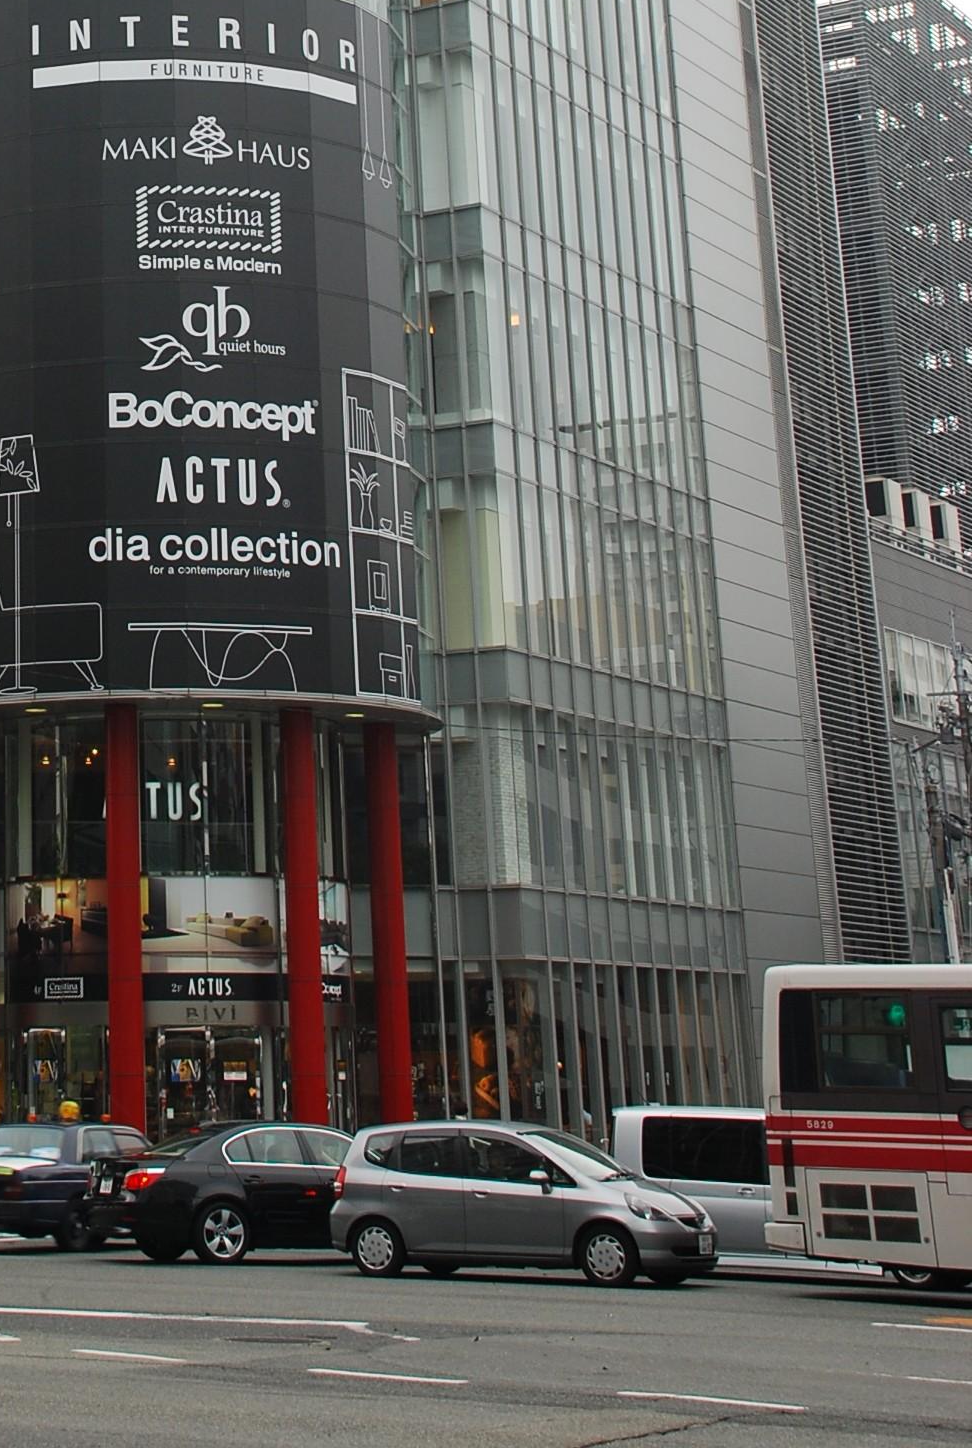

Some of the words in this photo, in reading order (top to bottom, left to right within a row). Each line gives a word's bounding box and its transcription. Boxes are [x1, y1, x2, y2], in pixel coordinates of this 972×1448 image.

[31, 15, 357, 72] INTERIOR
[150, 63, 265, 82] FURNITURE
[102, 137, 177, 161] MAKI
[237, 140, 311, 170] HAUS
[156, 200, 264, 227] Crastina
[158, 225, 195, 236] INTER
[198, 226, 265, 238] FURNITURE
[138, 254, 201, 271] Simple
[203, 259, 215, 270] &
[216, 256, 282, 274] Modern
[218, 340, 251, 354] quiet
[254, 340, 286, 356] hours
[88, 528, 151, 563] dia
[160, 527, 341, 568] collection
[149, 565, 165, 575] for
[167, 567, 175, 575] a
[178, 566, 250, 578] contemporary
[253, 566, 291, 578] lifestyle
[188, 978, 232, 996] ACTUS
